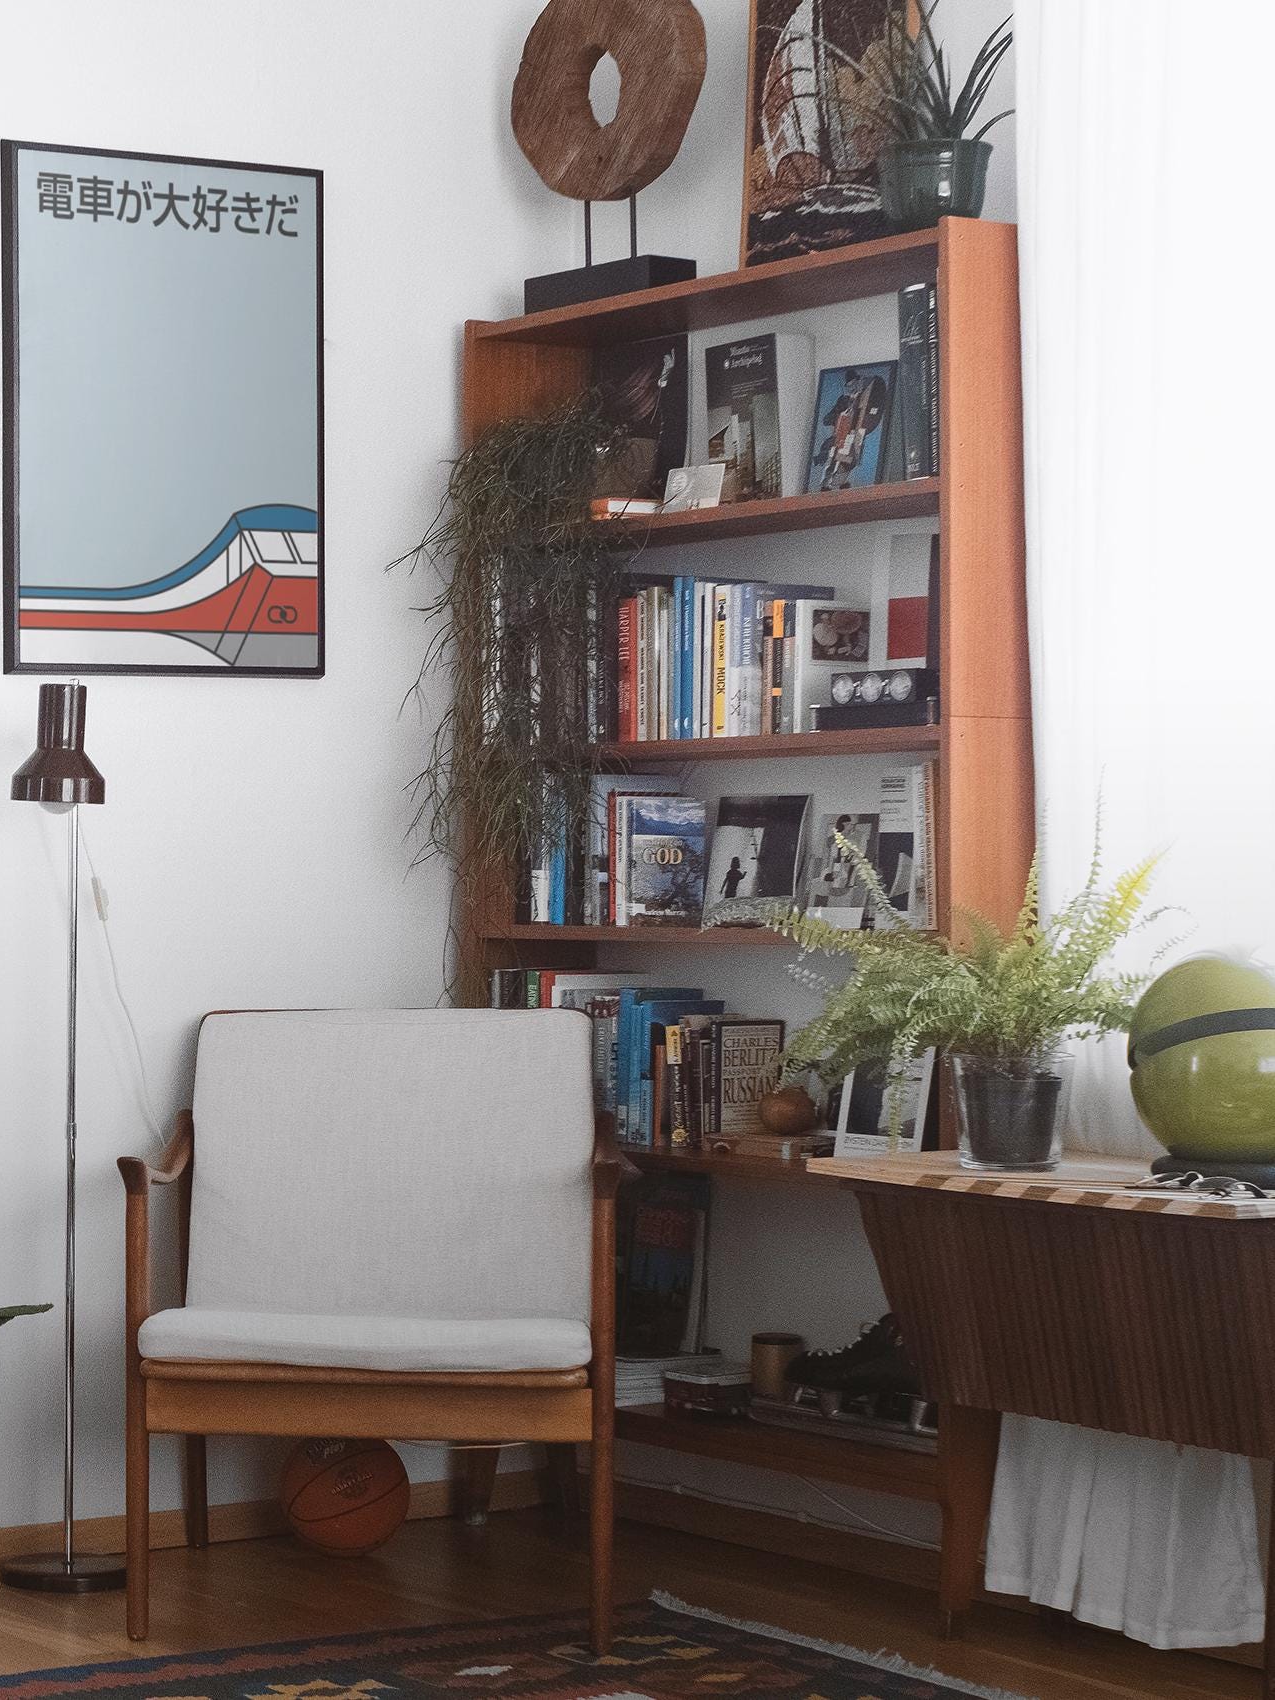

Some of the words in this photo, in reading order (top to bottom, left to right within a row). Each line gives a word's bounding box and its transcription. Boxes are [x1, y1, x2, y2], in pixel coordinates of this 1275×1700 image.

[36, 171, 299, 238] 電車が大好きだ
[618, 606, 629, 642] HARPER
[618, 645, 629, 661] LEE
[717, 667, 726, 694] MOCK
[643, 847, 682, 865] GOD
[723, 1037, 779, 1049] CHARLES
[723, 1048, 778, 1067] BERLITZ
